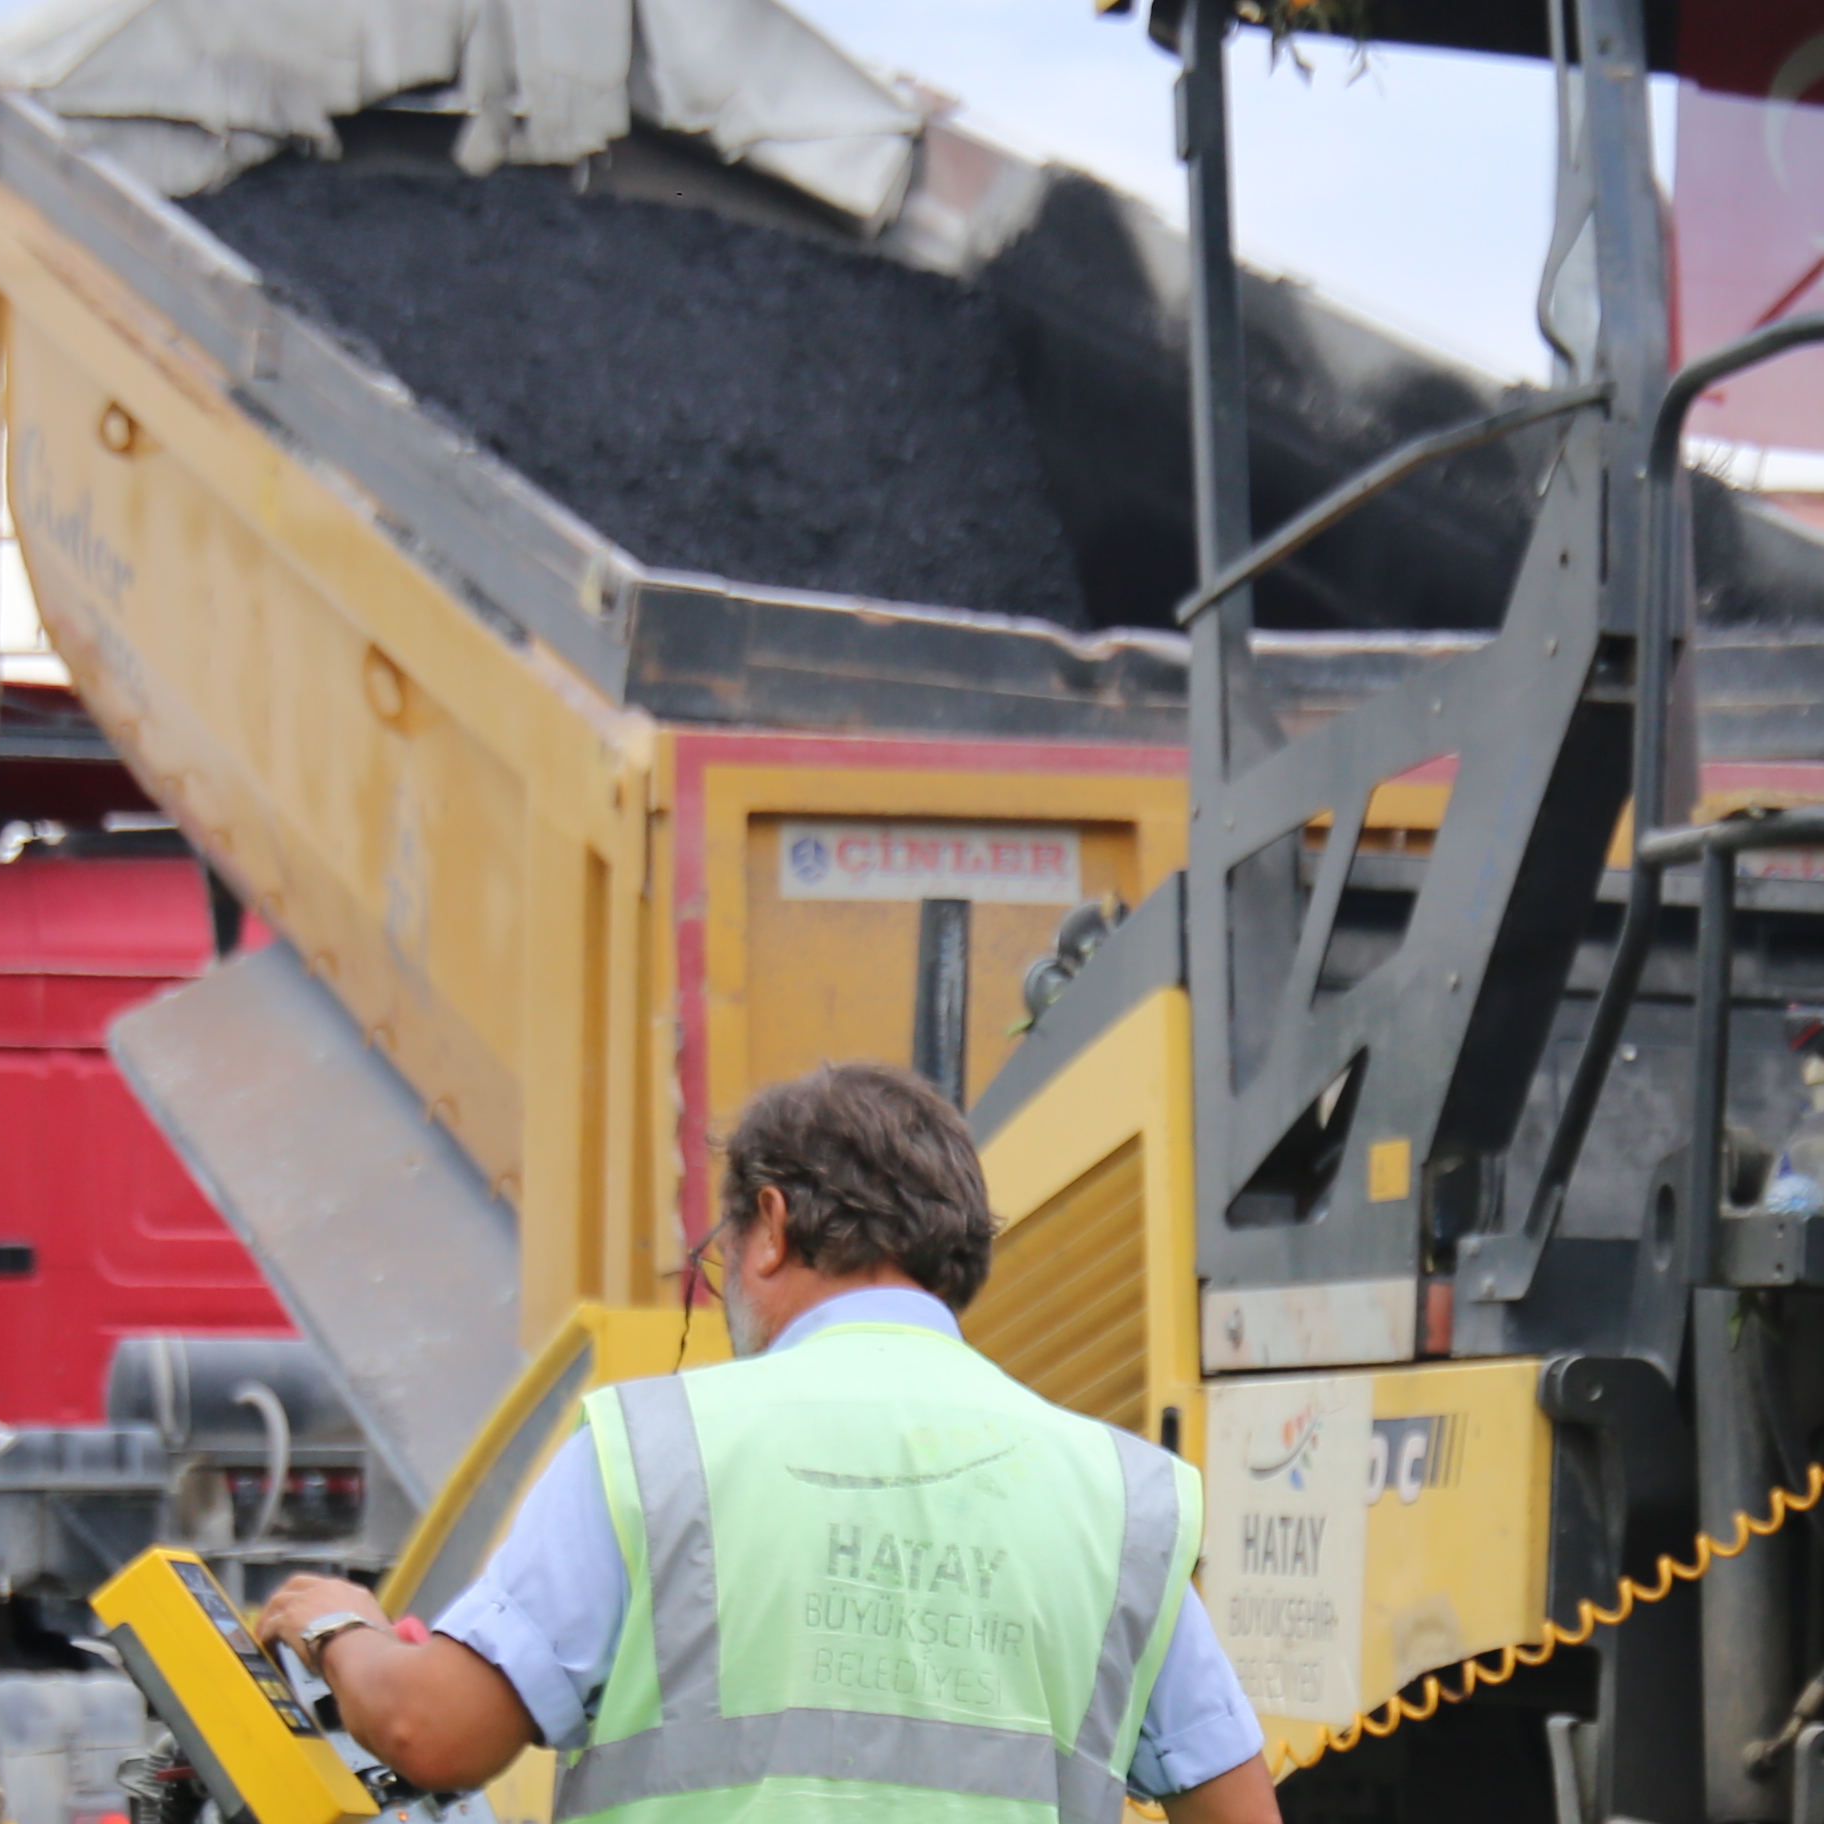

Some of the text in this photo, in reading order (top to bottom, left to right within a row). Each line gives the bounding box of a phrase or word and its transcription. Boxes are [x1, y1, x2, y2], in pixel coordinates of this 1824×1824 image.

[836, 830, 1068, 882] ÇİNLER
[827, 1523, 1008, 1601] HATAY
[1241, 1514, 1326, 1577] HATAY
